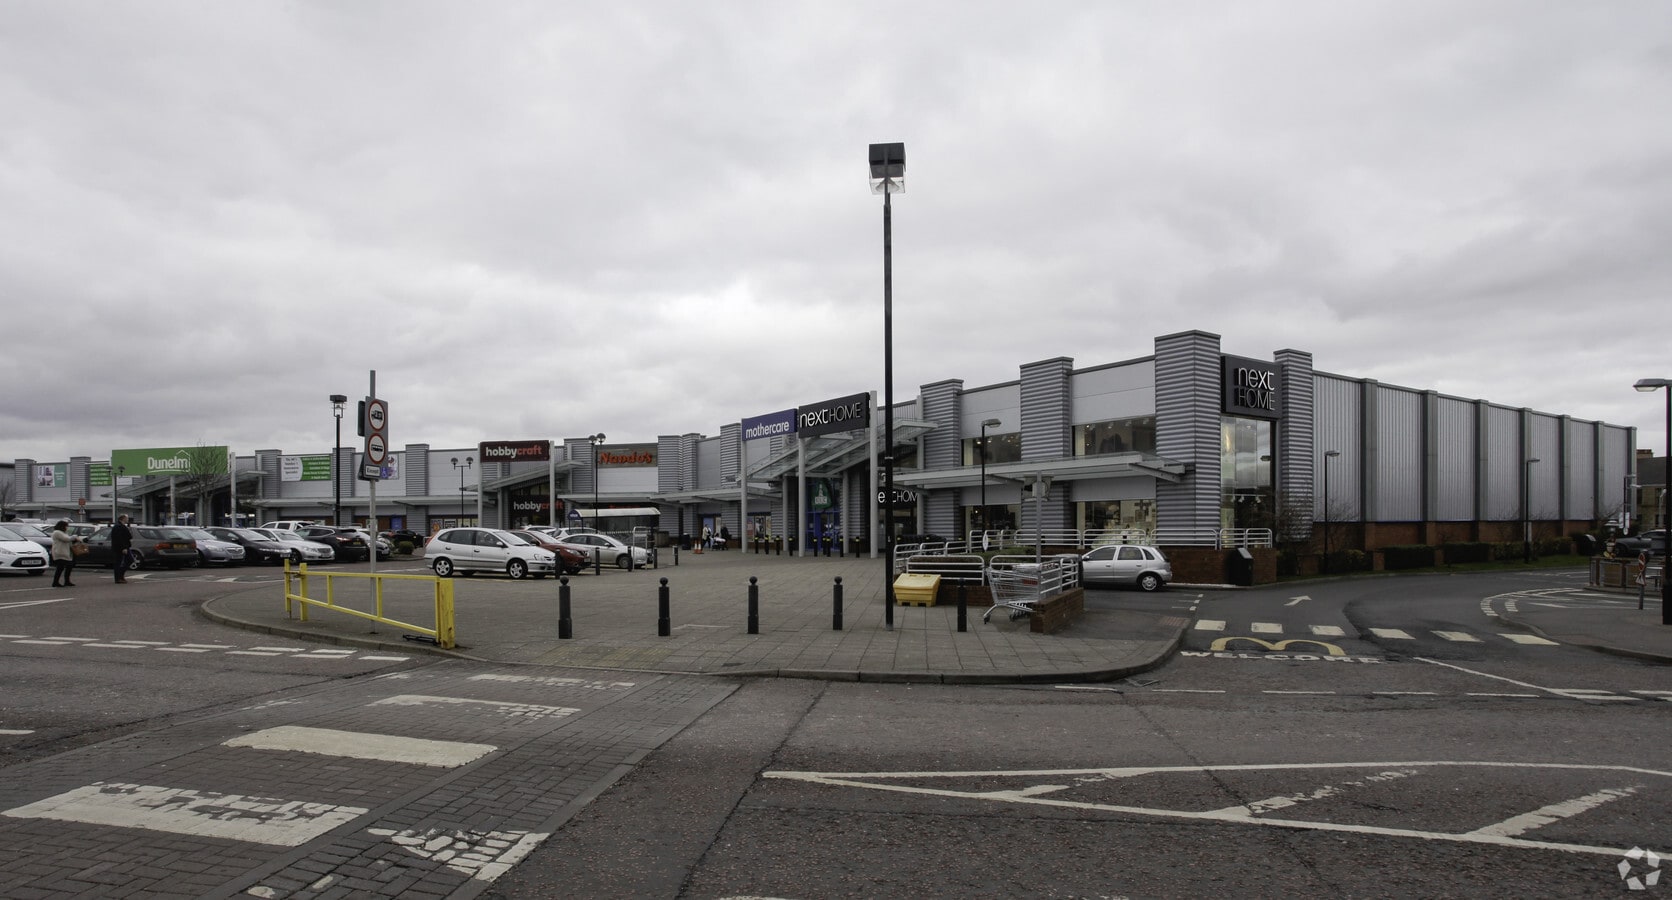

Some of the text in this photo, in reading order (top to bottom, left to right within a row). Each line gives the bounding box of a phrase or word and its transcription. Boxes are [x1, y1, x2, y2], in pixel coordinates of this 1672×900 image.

[1238, 367, 1275, 391] next
[1238, 388, 1276, 411] HOME
[745, 420, 790, 439] mothercare
[485, 444, 543, 459] hobbycraft
[599, 451, 652, 463] Nando's
[147, 455, 188, 470] Dunelm
[513, 500, 564, 513] hobbycrft
[1180, 651, 1383, 663] WELCOME
